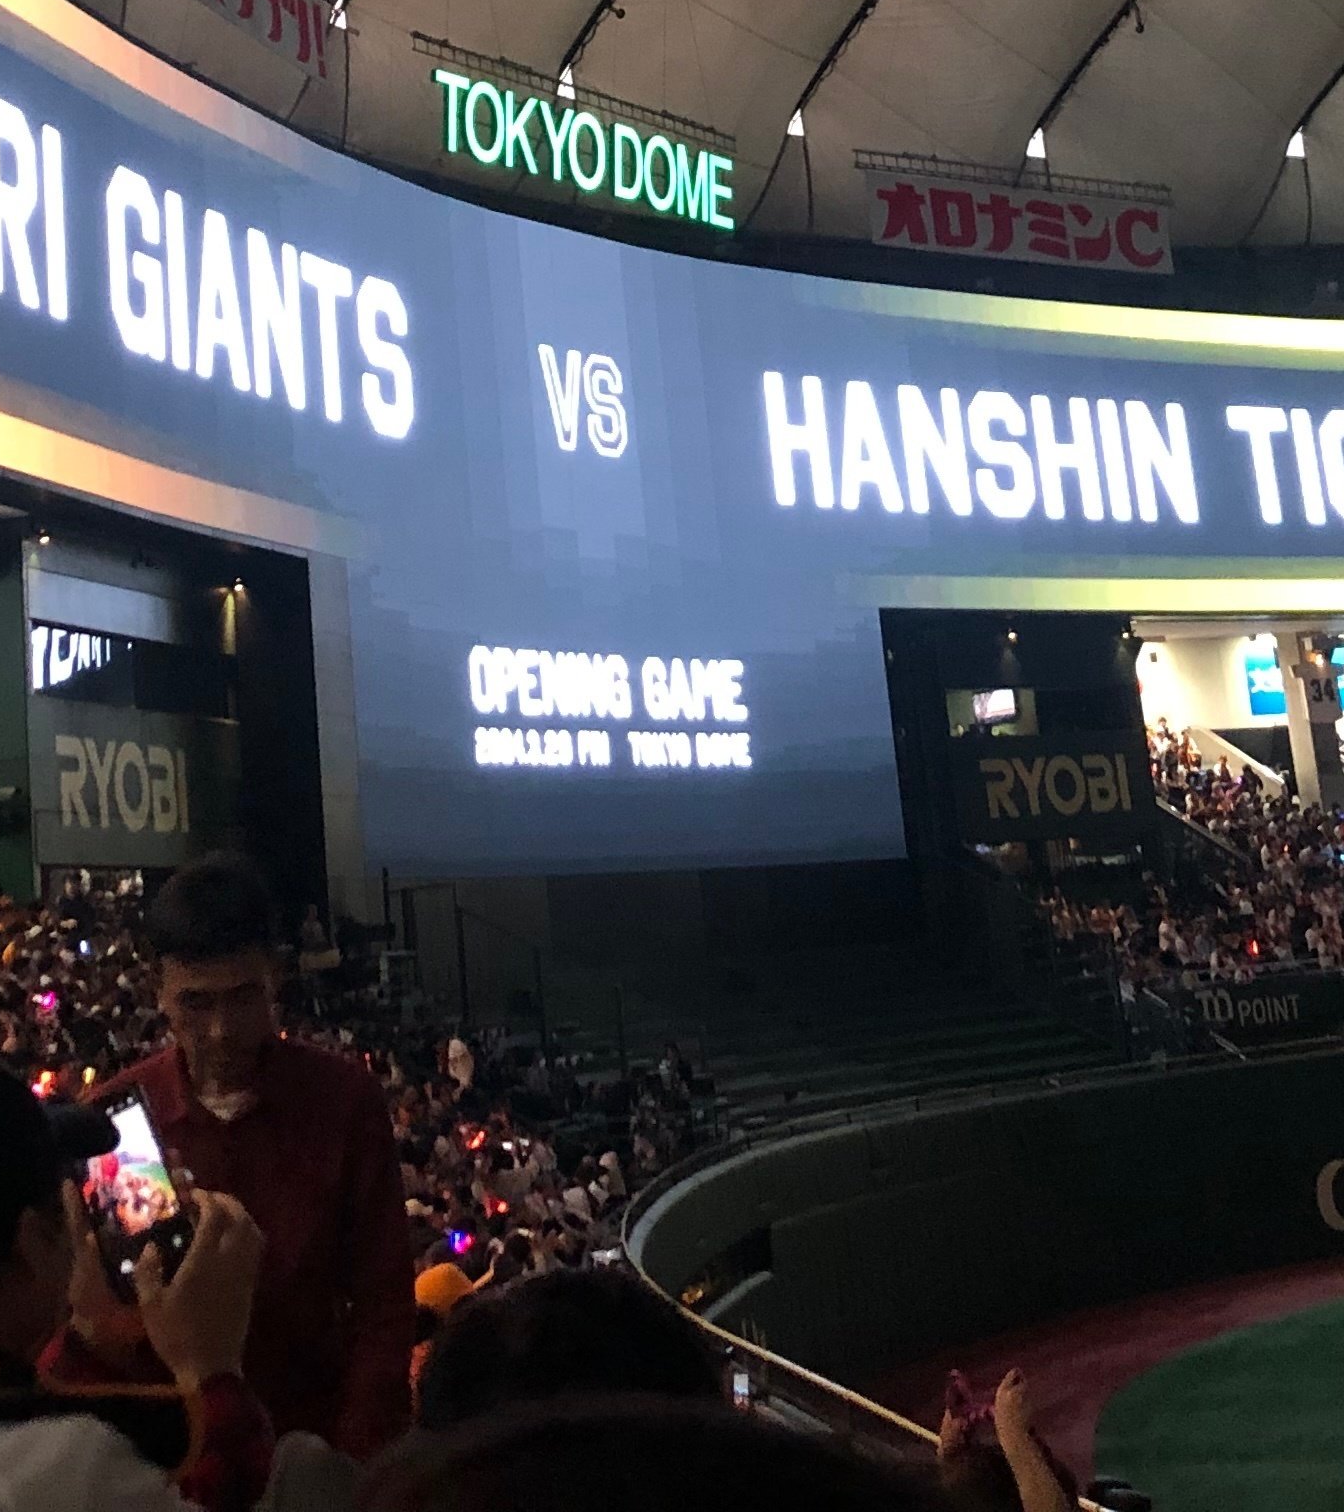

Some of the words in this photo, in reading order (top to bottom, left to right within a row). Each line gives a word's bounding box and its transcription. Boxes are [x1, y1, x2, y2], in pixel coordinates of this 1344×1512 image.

[434, 68, 605, 191] TOKYO
[613, 122, 735, 230] DOME
[875, 181, 1165, 269] オロナミンC
[105, 164, 415, 441] GIANTS
[537, 343, 628, 459] VS
[762, 370, 1200, 525] HANSHIN
[468, 645, 632, 719] OPENING
[642, 656, 749, 721] GAME
[55, 735, 189, 834] RYOBI
[980, 753, 1132, 819] RYOBI
[1237, 994, 1299, 1027] POINT
